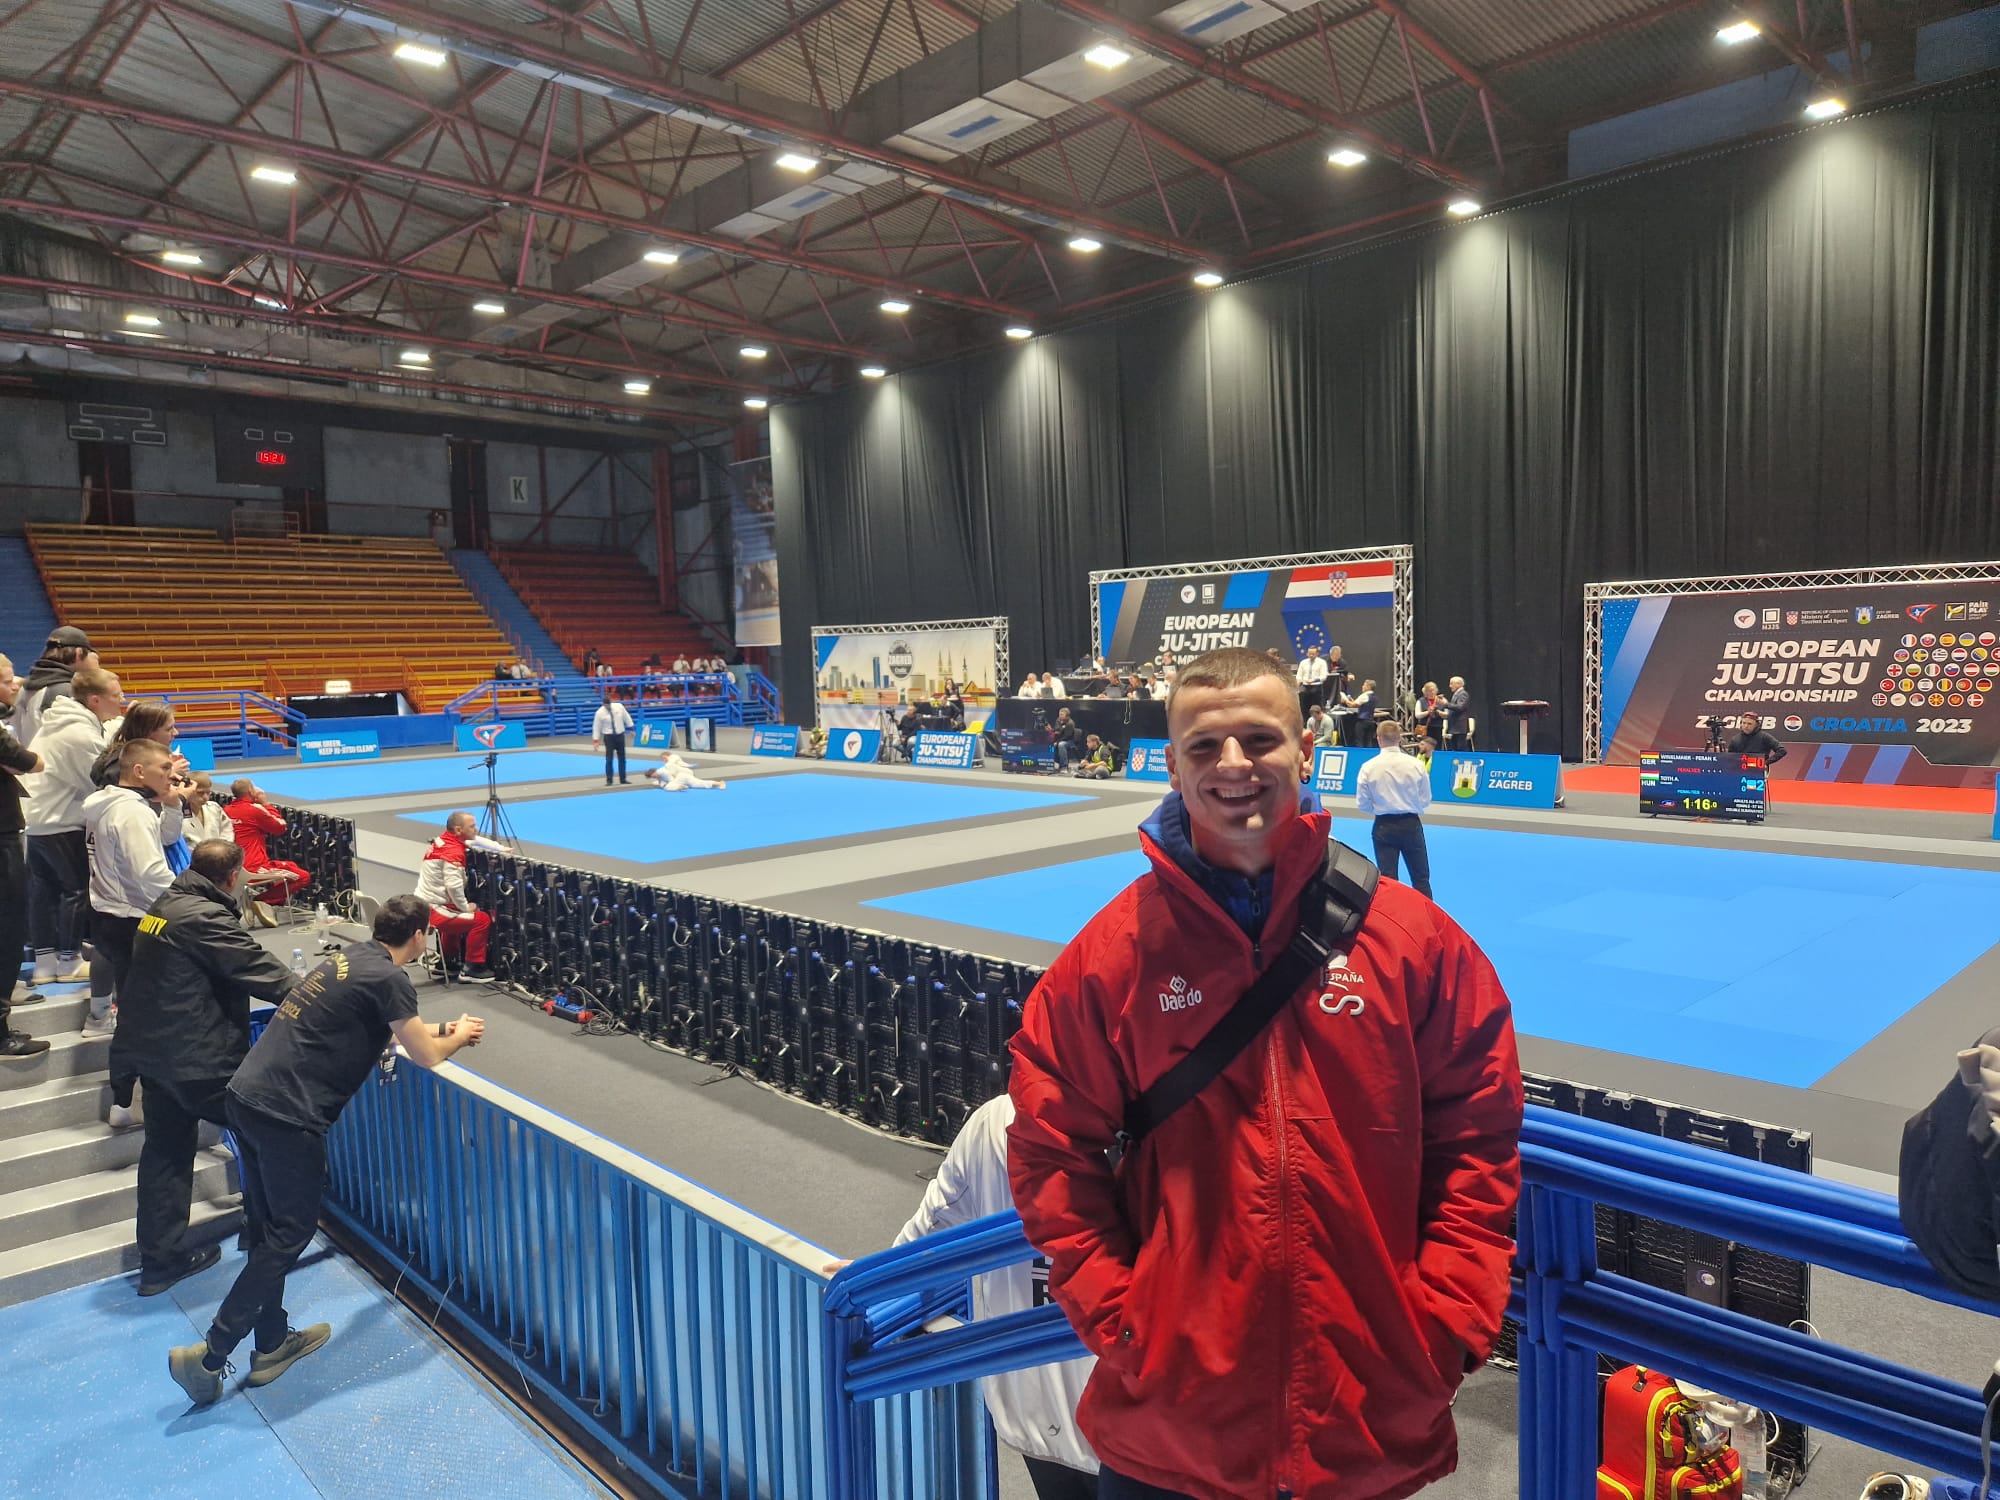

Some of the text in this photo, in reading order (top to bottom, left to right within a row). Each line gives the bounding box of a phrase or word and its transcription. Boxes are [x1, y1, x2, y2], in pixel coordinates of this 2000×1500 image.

[260, 452, 284, 463] 15:21
[513, 479, 524, 500] K
[1164, 612, 1255, 631] EUROPEAN
[1158, 631, 1249, 652] JU-JITSU
[1723, 639, 1881, 660] EUROPEAN
[1712, 662, 1870, 686] JU-JITSU
[1704, 689, 1858, 703] CHAMPIONSHIP
[1810, 717, 1908, 733] CROATIA
[1915, 718, 1973, 734] 2023
[920, 733, 966, 744] EUROPEAN
[917, 744, 964, 758] JU-JITSU
[1641, 758, 1656, 766] GER
[1824, 756, 1832, 769] 1
[1490, 770, 1507, 778] CITY
[1316, 780, 1343, 791] HJJS
[1488, 779, 1533, 791] ZAGREB
[1641, 779, 1656, 787] HUN
[1757, 780, 1764, 791] 2
[1329, 971, 1365, 984] SPAÑA
